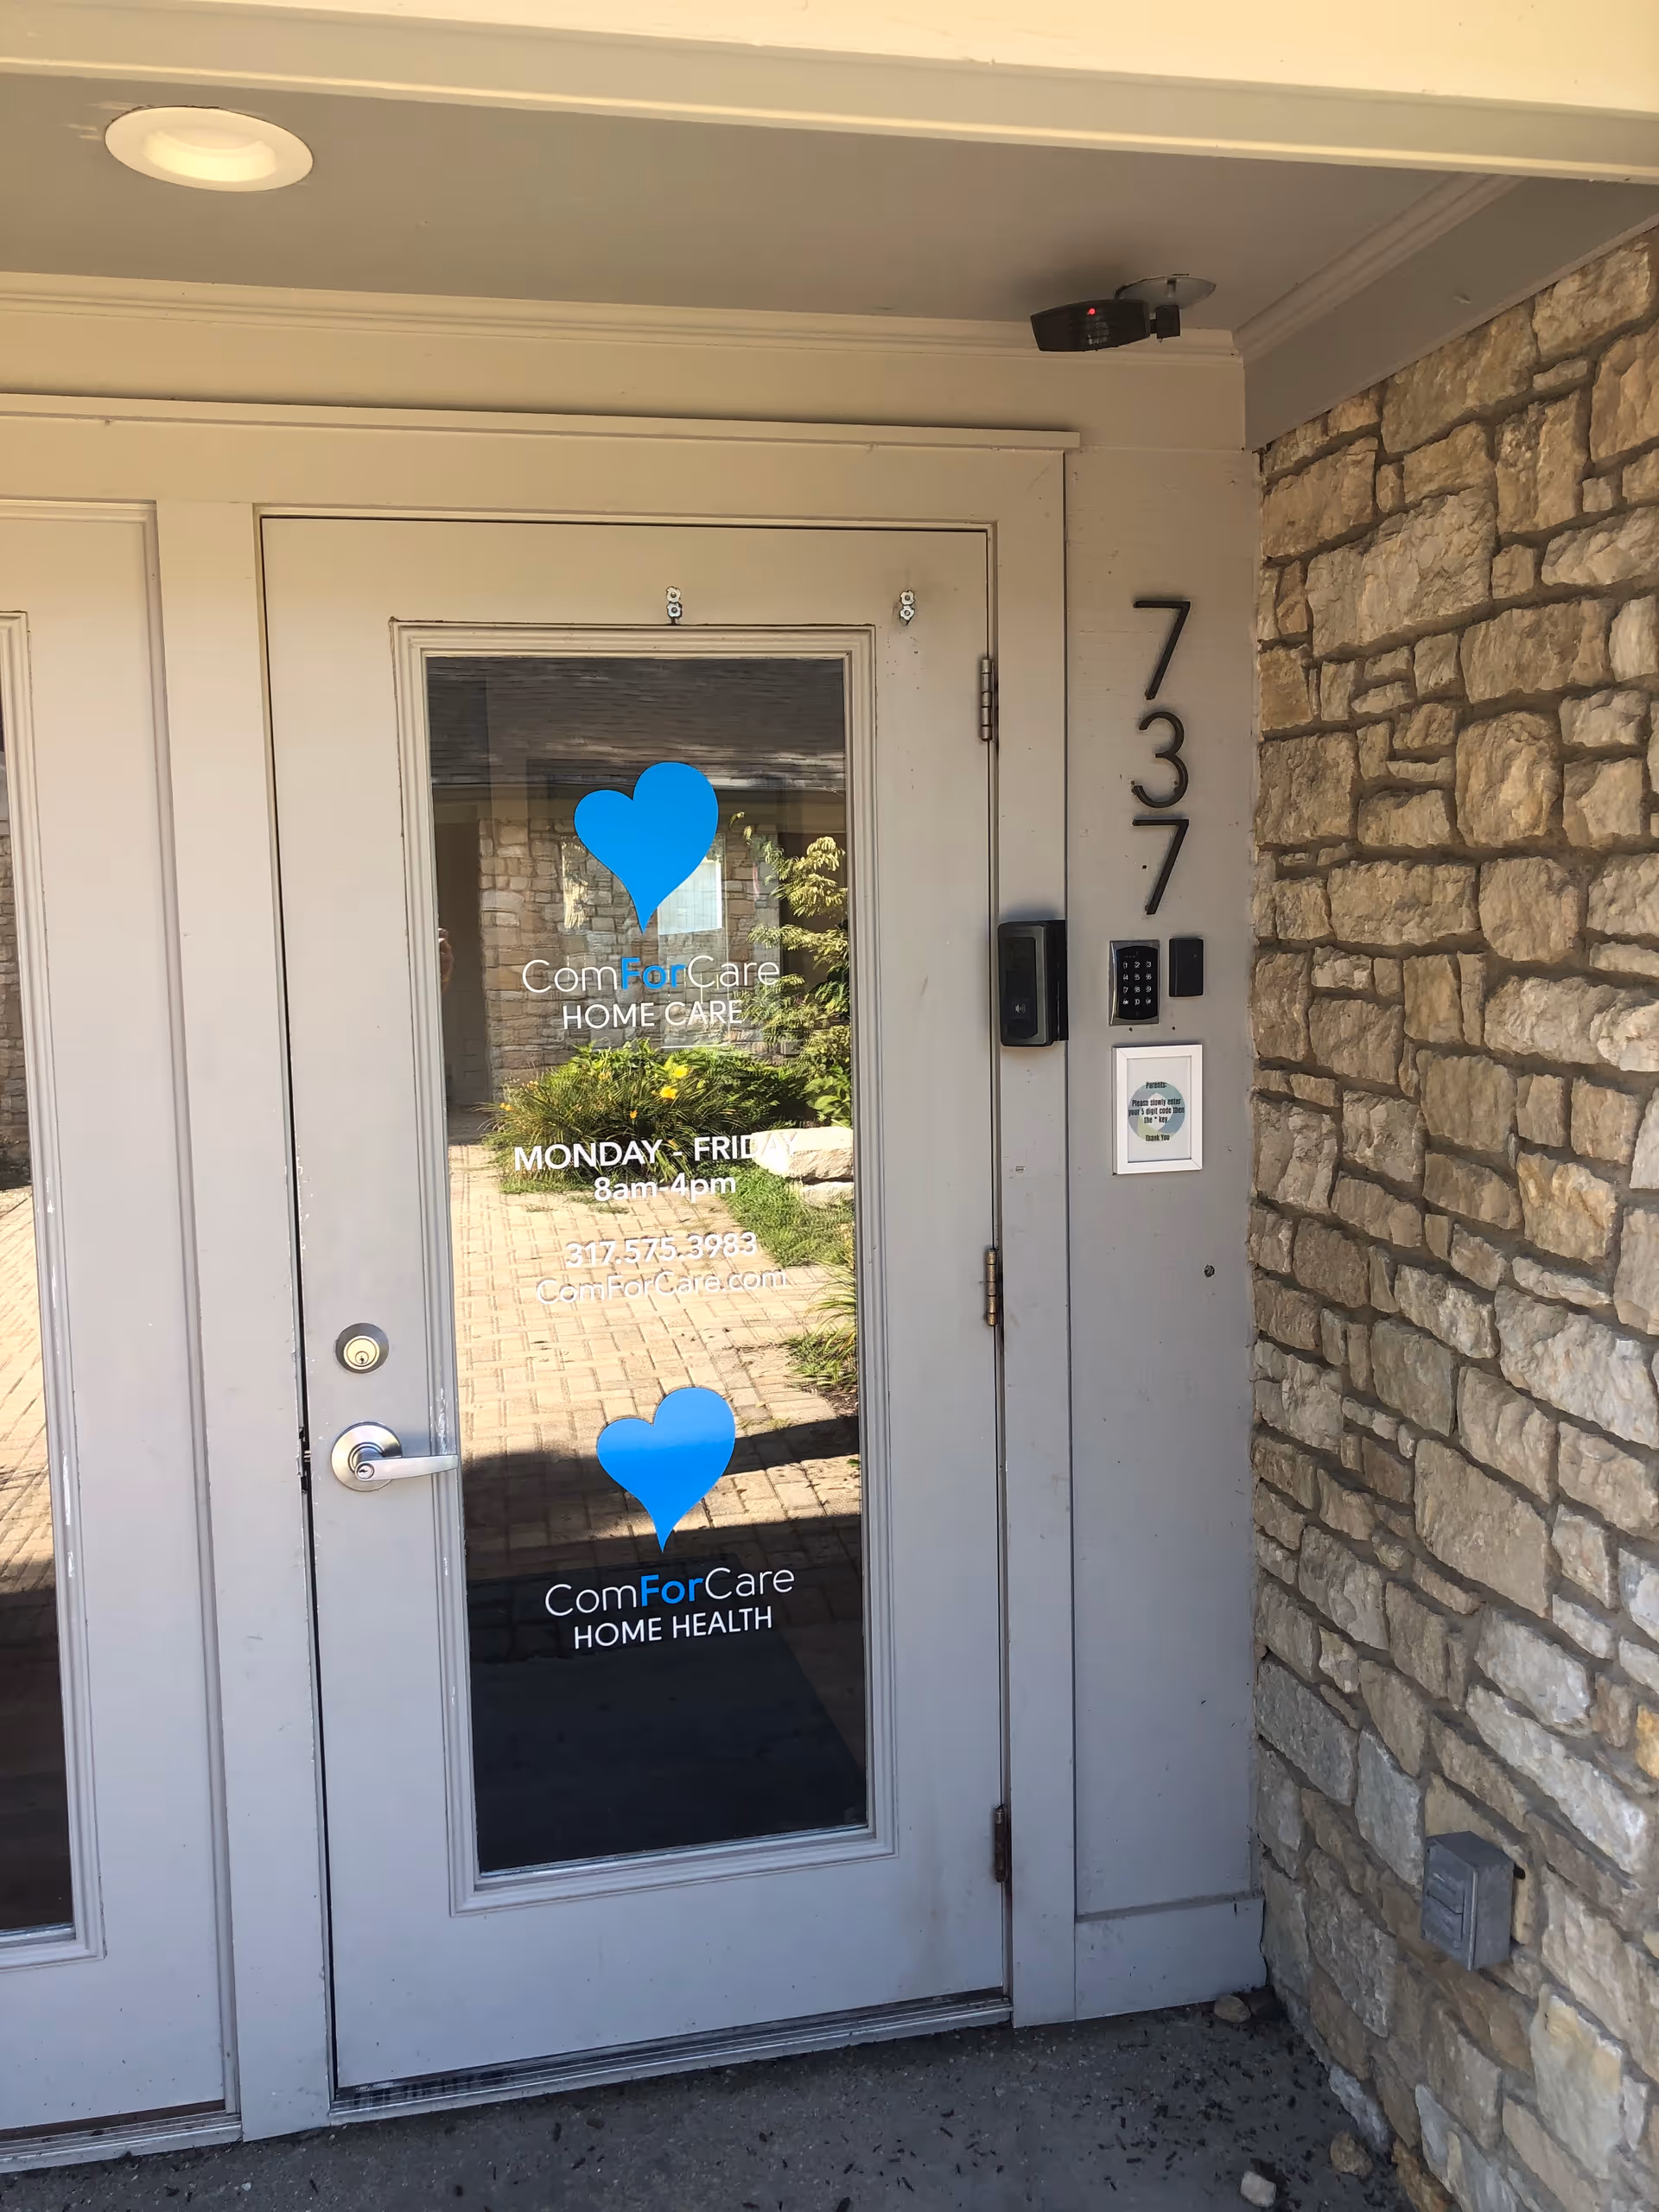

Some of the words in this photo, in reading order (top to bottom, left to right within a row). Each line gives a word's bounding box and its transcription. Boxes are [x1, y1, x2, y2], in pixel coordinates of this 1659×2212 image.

[1133, 600, 1191, 915] 737
[522, 955, 780, 994] ComForCare
[563, 1002, 655, 1030] HOME
[664, 1000, 743, 1027] CARE
[1146, 1107, 1158, 1116] digit
[514, 1139, 664, 1172] MONDAY
[594, 1172, 736, 1204] 8am-4pm
[565, 1231, 757, 1268] 317.575.3983
[536, 1268, 787, 1306] ComForCare.com
[544, 1567, 795, 1617] ComForCare
[574, 1617, 663, 1649] HOME
[672, 1605, 772, 1638] HEALTH
